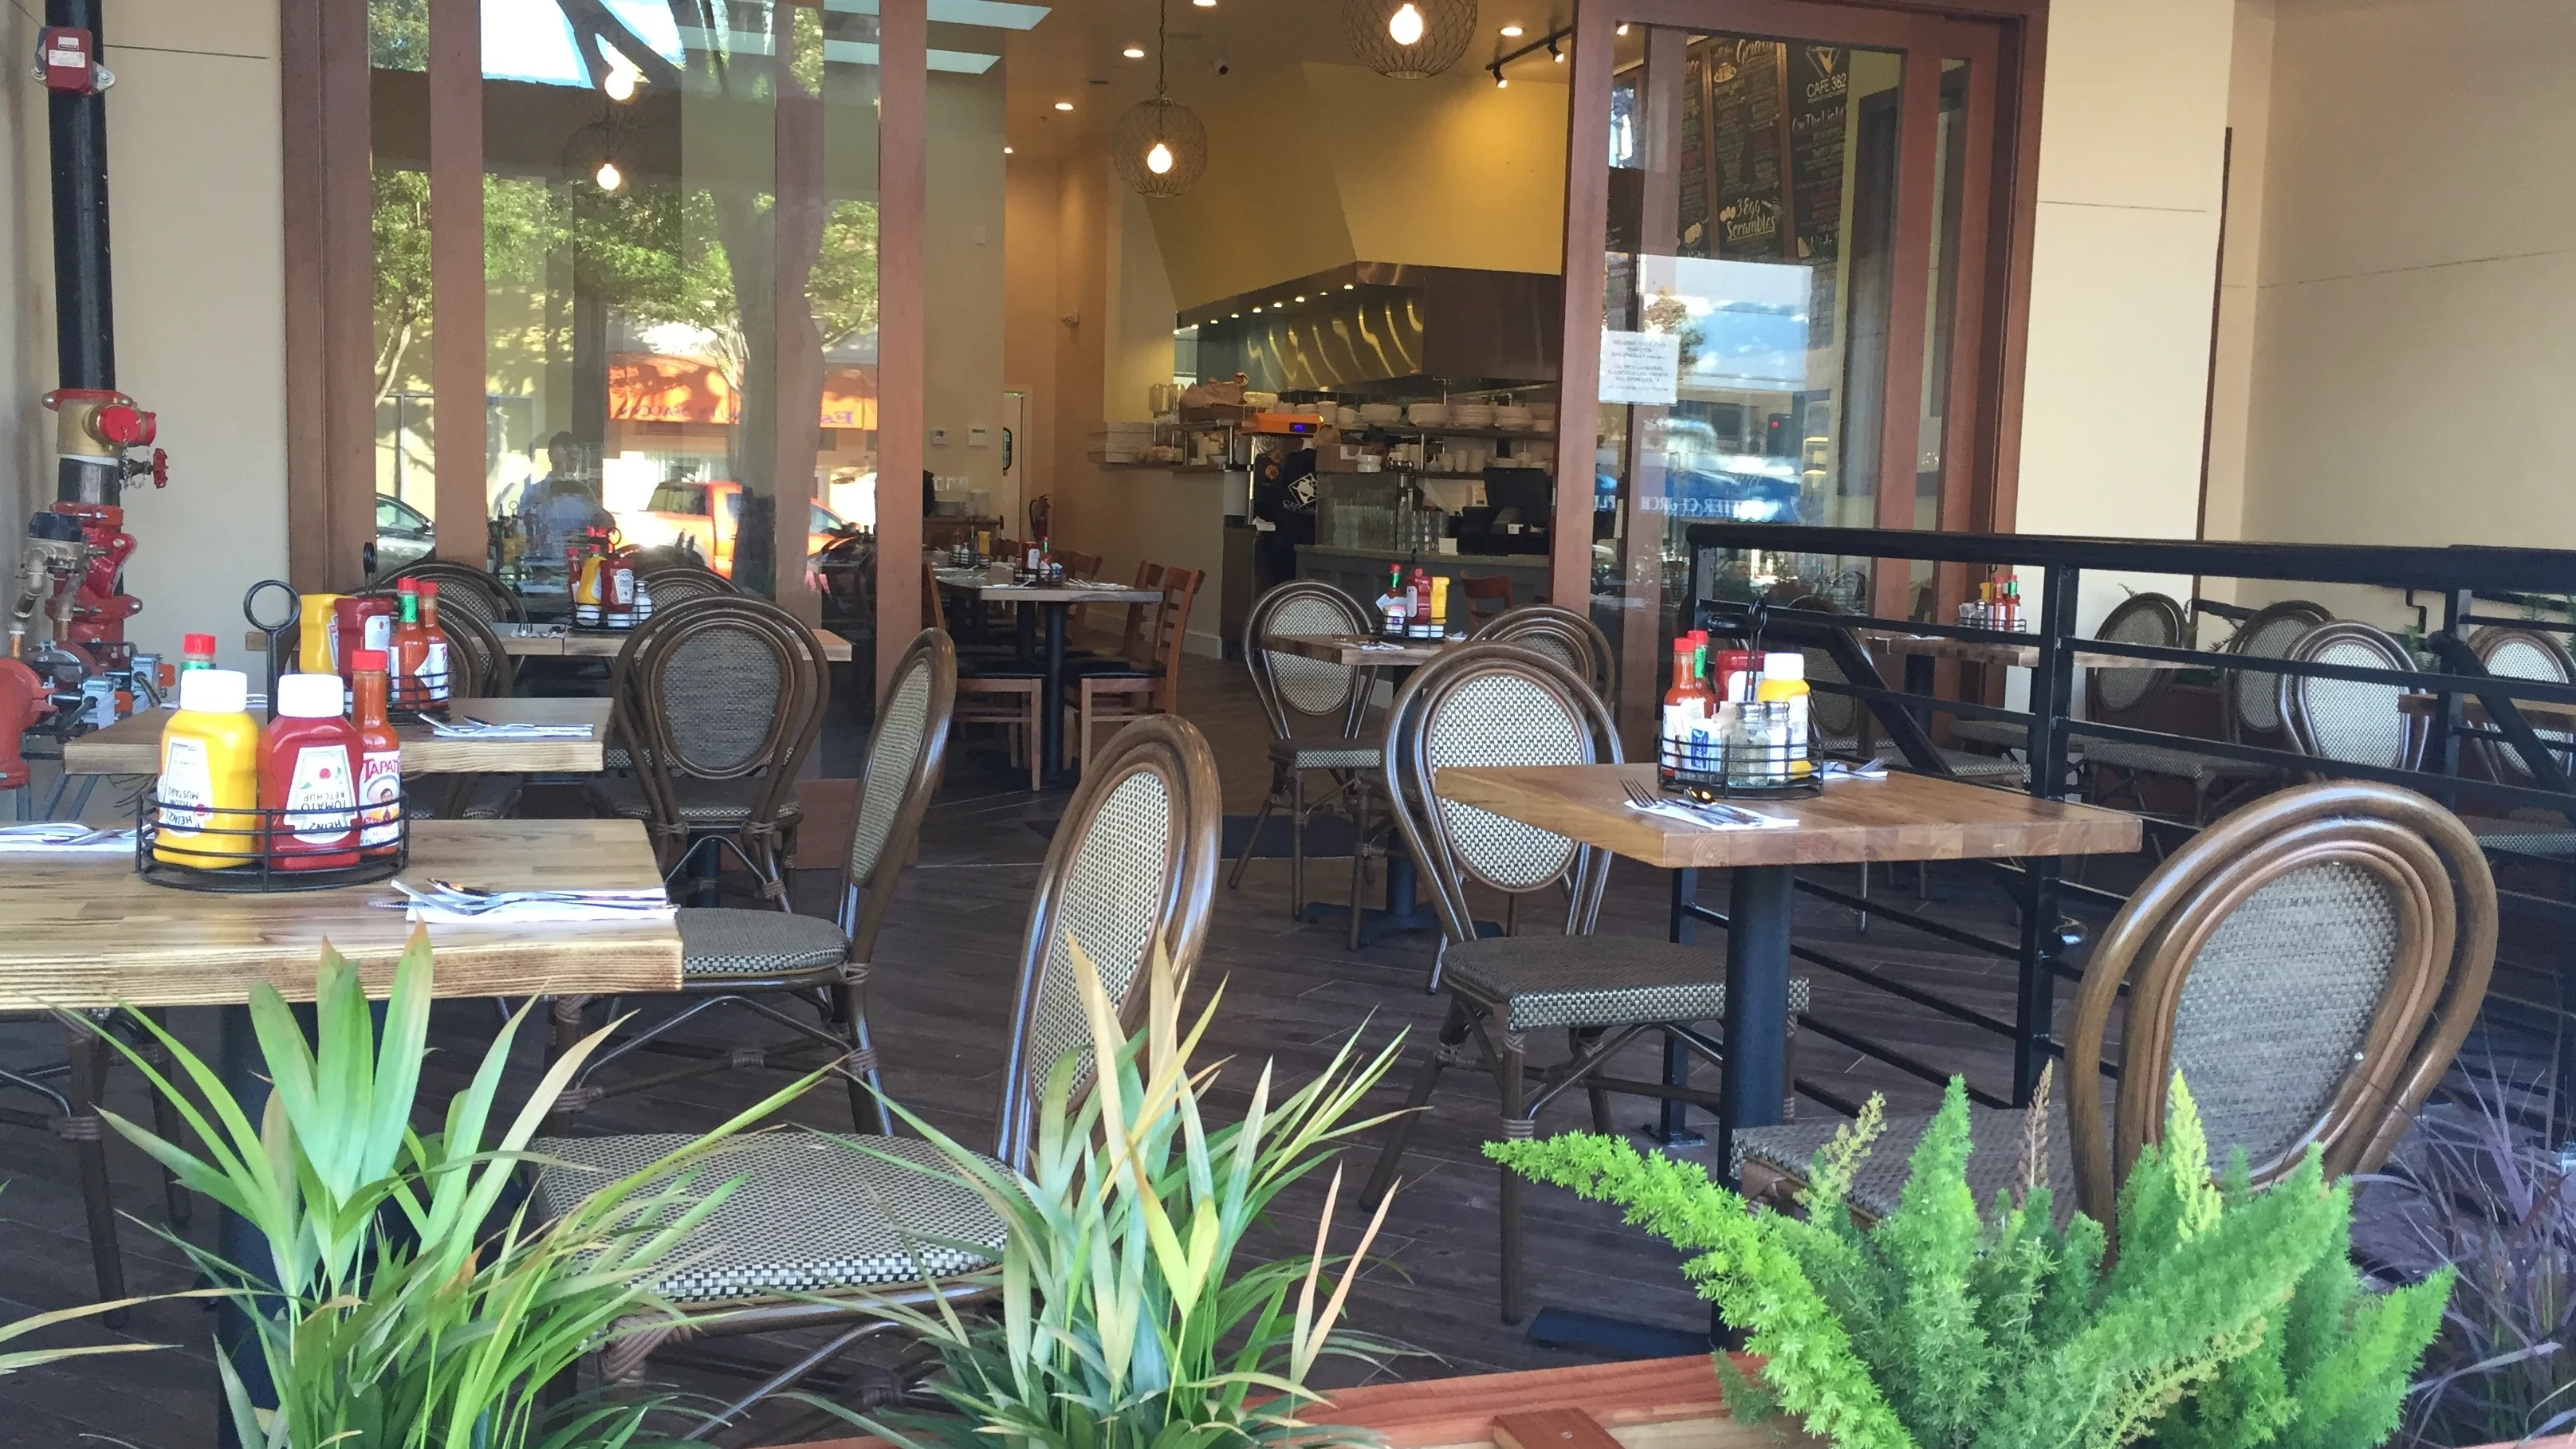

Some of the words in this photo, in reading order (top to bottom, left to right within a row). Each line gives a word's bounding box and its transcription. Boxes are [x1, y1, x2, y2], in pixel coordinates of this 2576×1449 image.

[1807, 78, 1831, 98] CAFE
[1831, 73, 1847, 91] 382
[1743, 197, 1760, 220] Egg
[1726, 213, 1776, 239] Scrambles
[303, 791, 345, 803] KETCHUP
[301, 799, 346, 811] TOMATO
[168, 811, 193, 824] HEINZ
[309, 819, 342, 831] HEINZ
